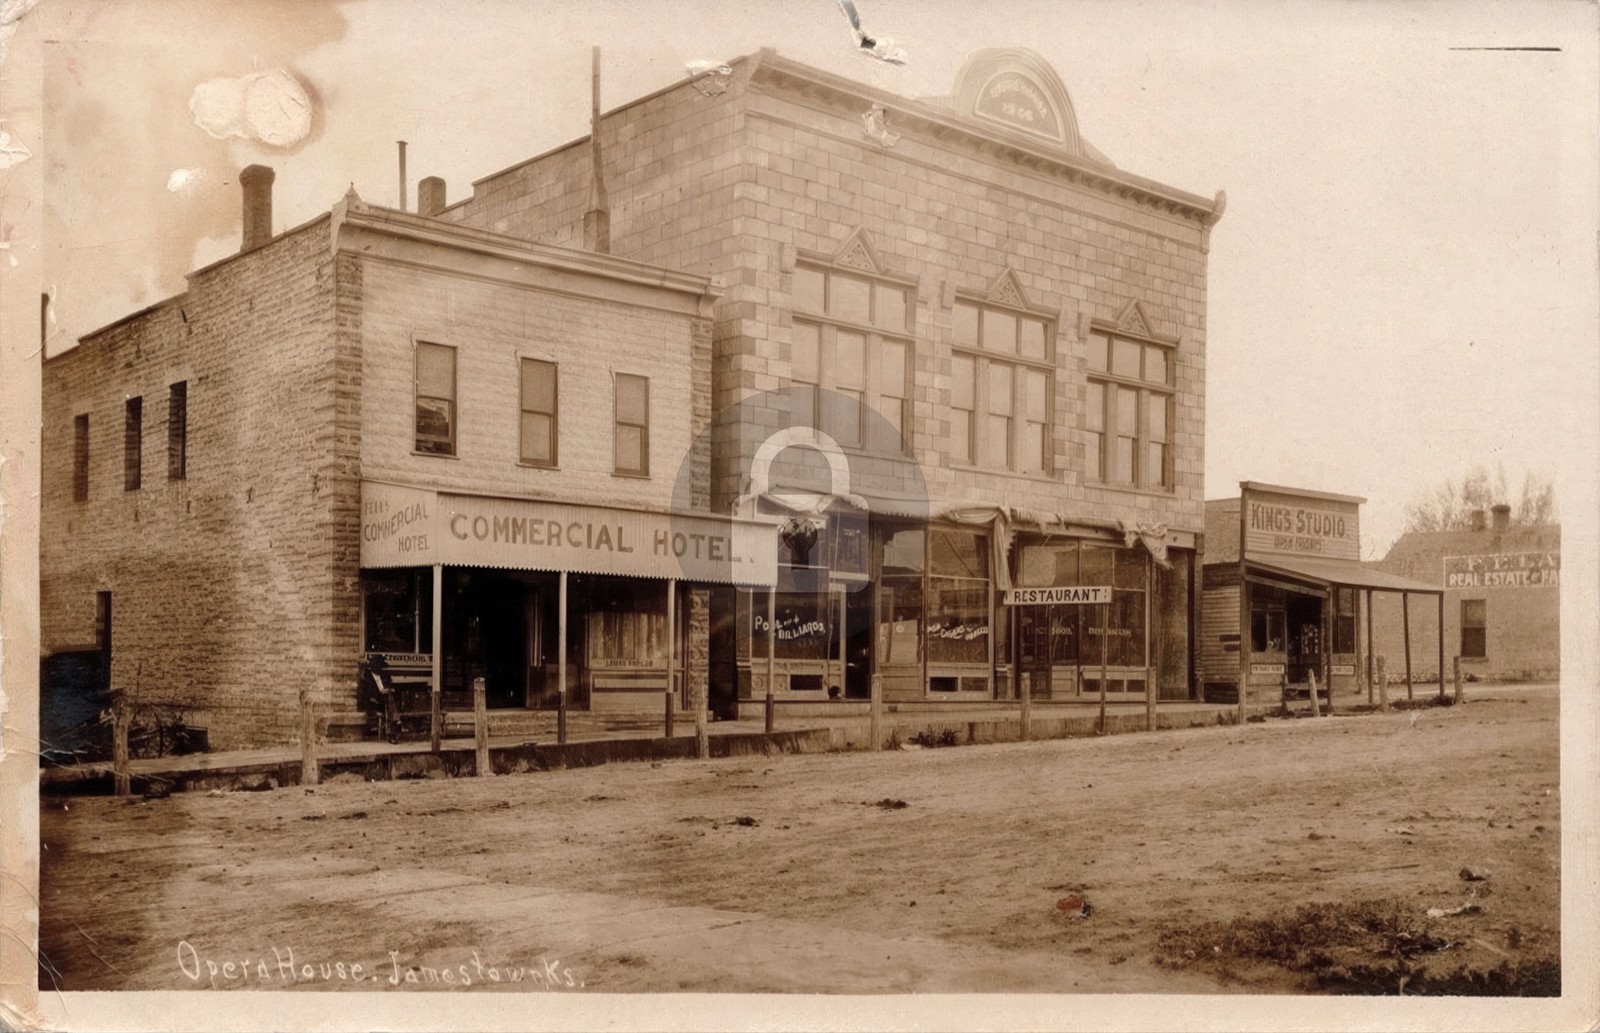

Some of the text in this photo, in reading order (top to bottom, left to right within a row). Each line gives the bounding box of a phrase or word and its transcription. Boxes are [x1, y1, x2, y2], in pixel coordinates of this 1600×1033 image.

[363, 500, 429, 542] COMMERCIAL
[449, 513, 634, 553] COMMERCIAL
[1296, 508, 1346, 538] STUDIO
[398, 534, 431, 553] HOTEL
[1448, 572, 1480, 587] REAL
[1014, 588, 1101, 603] RESTAURANT
